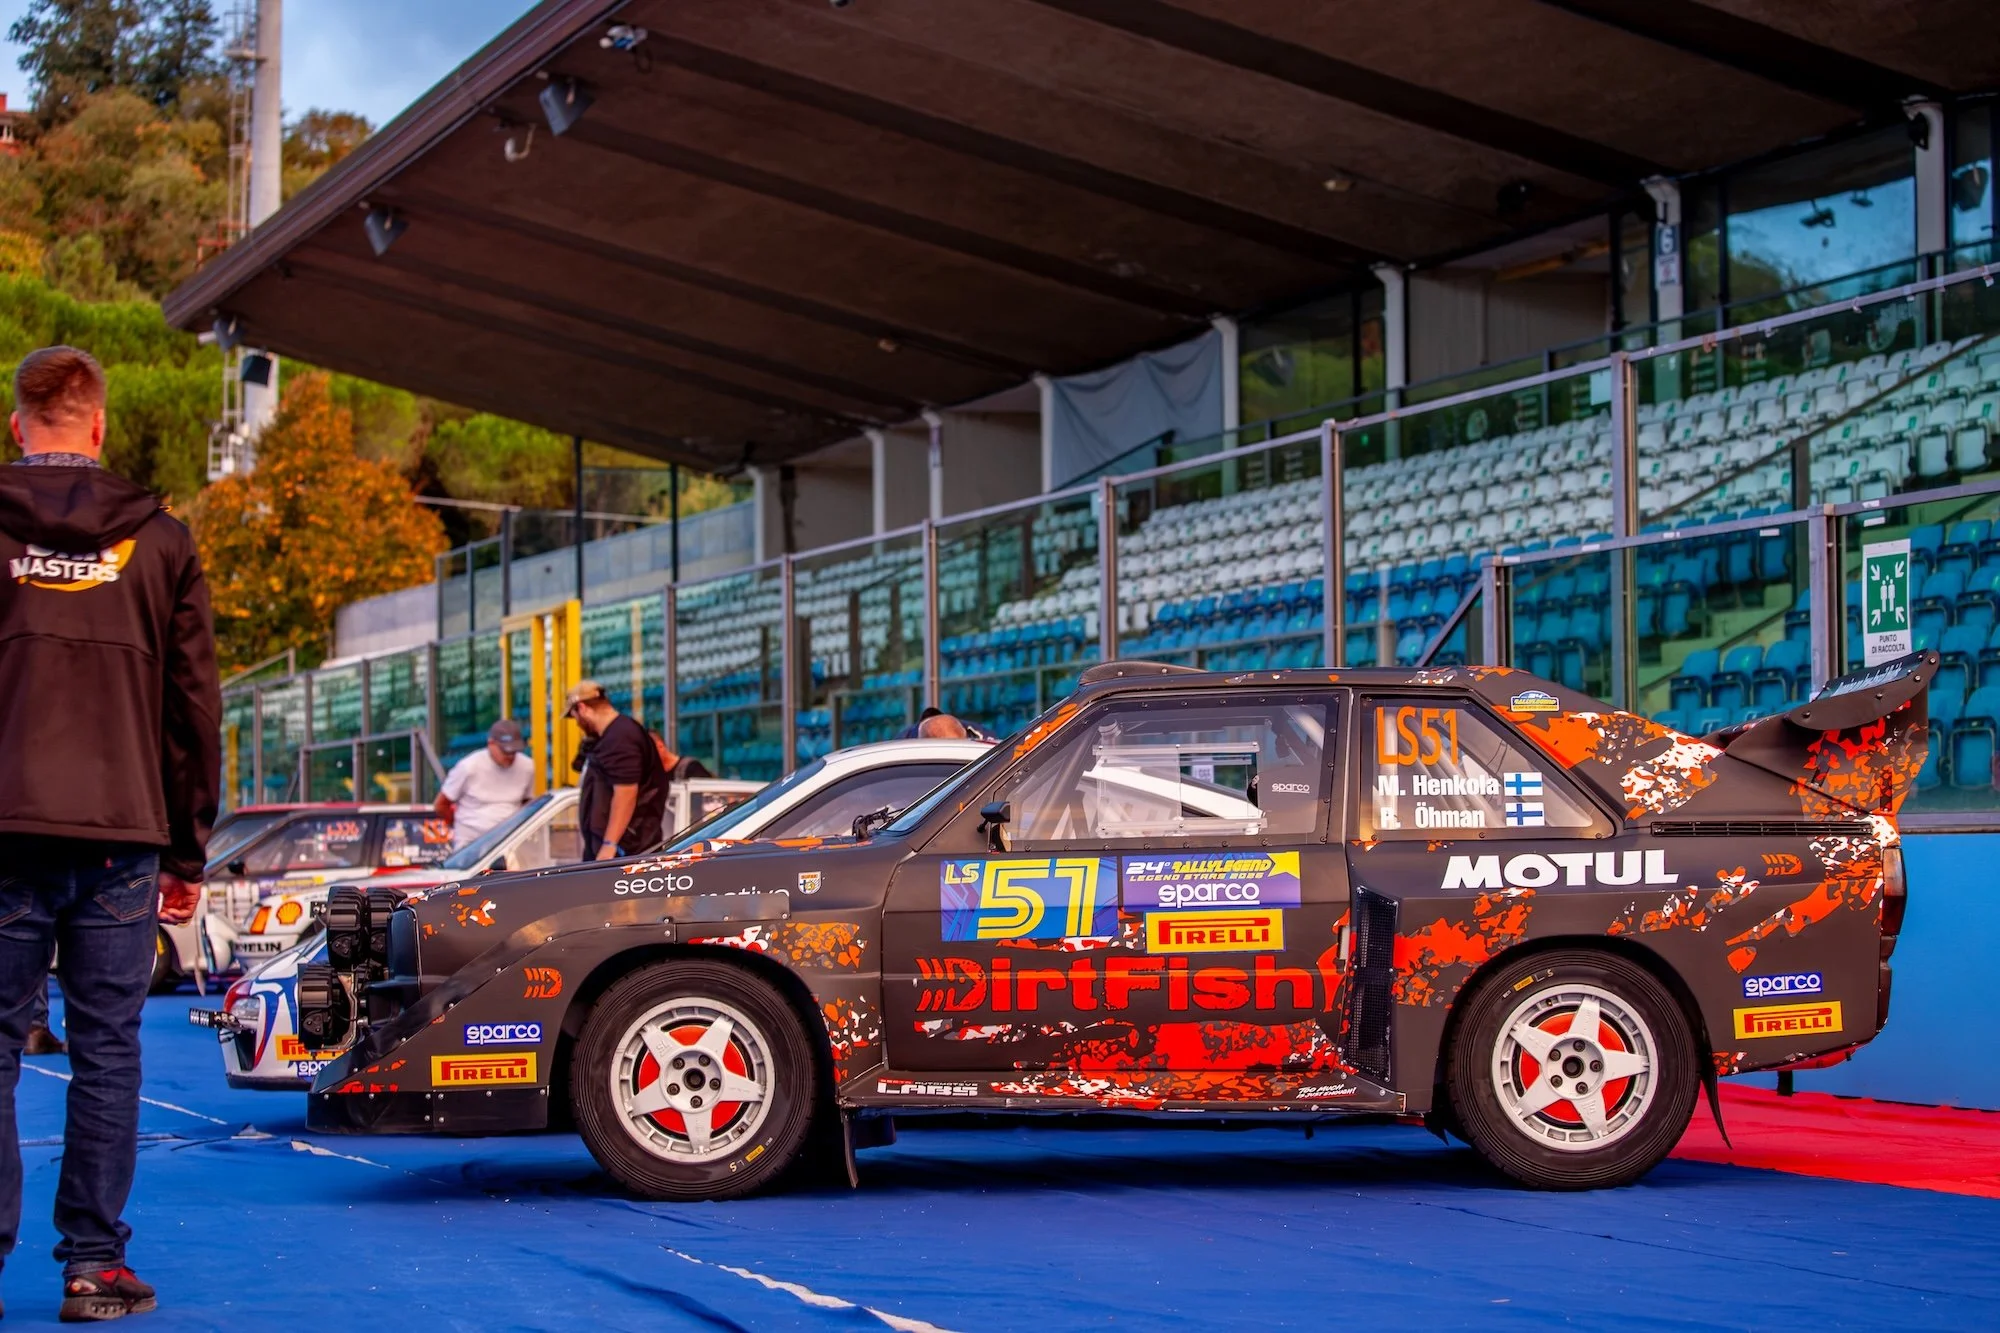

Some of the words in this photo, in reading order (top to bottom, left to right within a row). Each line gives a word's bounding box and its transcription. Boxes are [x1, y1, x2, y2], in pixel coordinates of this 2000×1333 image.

[9, 557, 120, 582] MASTERS
[1871, 646, 1878, 654] DI
[1878, 643, 1905, 653] RACCOLTA
[1879, 634, 1897, 642] PUNTO
[1376, 705, 1459, 766] LS51
[1271, 782, 1310, 794] sparco
[1378, 775, 1406, 796] M.
[1412, 774, 1500, 796] Henkola
[1380, 806, 1401, 828] R.
[1415, 802, 1486, 828] Öhman
[1129, 874, 1179, 882] LEGEND
[1183, 872, 1226, 881] STARS
[1440, 850, 1680, 889] MOTUL
[613, 873, 694, 895] secto
[1158, 882, 1261, 908] sparco
[944, 863, 980, 885] LS
[976, 858, 1100, 939] 51
[1158, 917, 1271, 945] PIRELLI
[915, 954, 1313, 1012] DirtFish
[1745, 974, 1821, 997] sparco
[1743, 1008, 1833, 1033] PIRELLI
[466, 1024, 541, 1045] sparco
[441, 1058, 528, 1081] PIRELLI
[877, 1082, 978, 1097] LABS
[1317, 1084, 1344, 1093] MUCH
